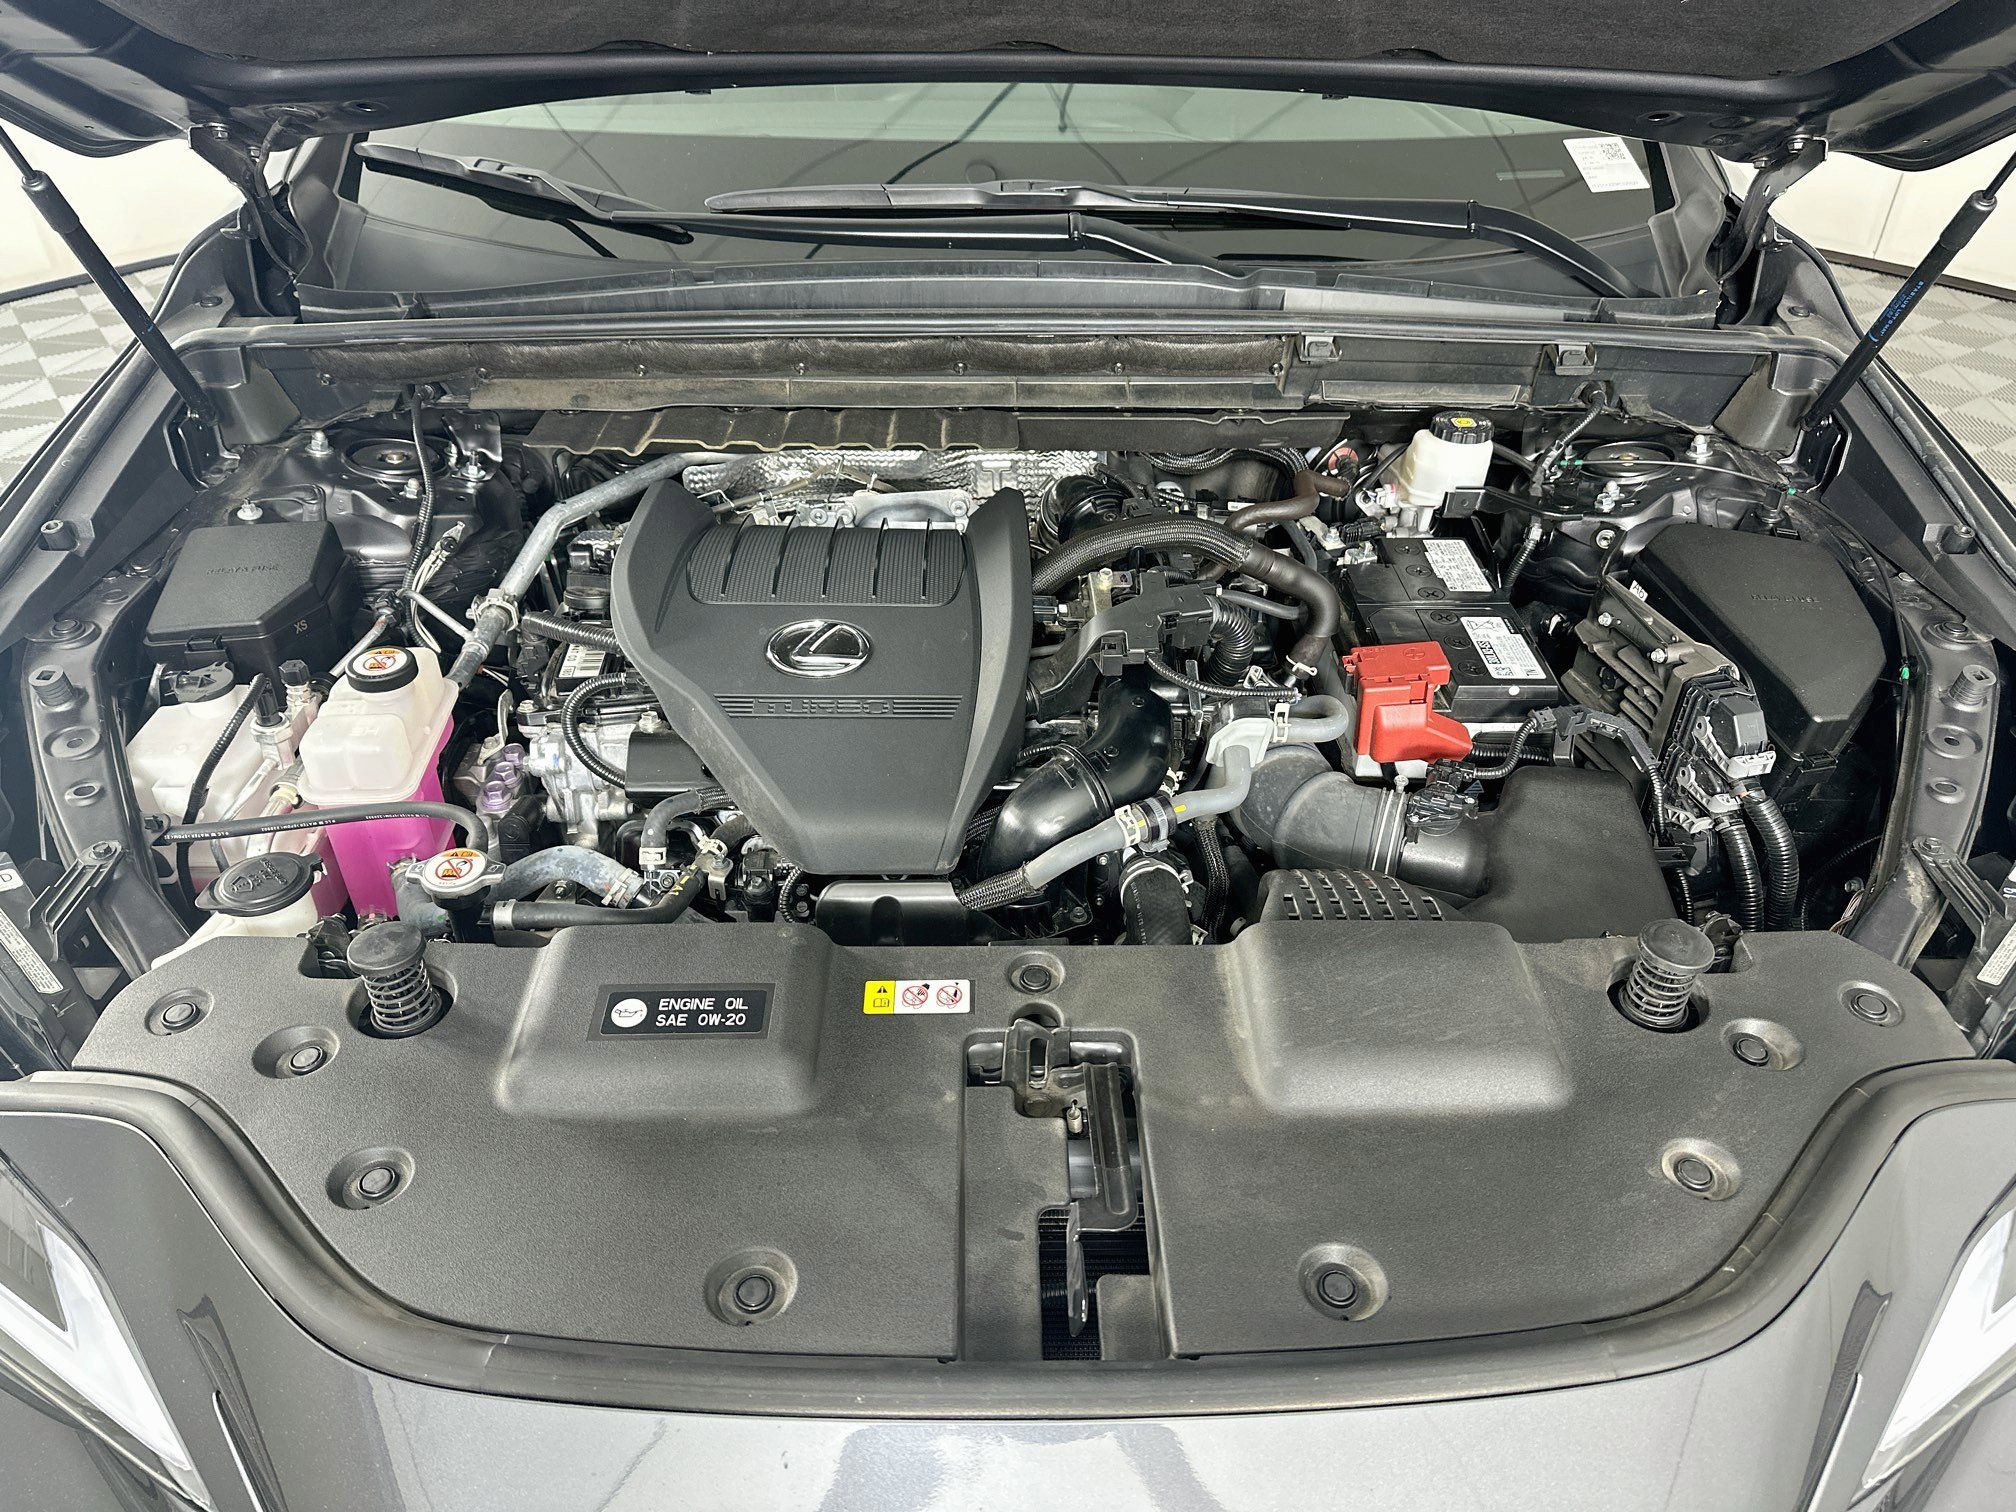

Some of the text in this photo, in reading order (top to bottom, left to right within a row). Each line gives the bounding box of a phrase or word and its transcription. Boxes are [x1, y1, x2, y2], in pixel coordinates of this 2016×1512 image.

[754, 698, 889, 714] TURBO
[658, 997, 749, 1011] ENGINE OIL
[656, 1013, 746, 1026] SAE 0W-20
